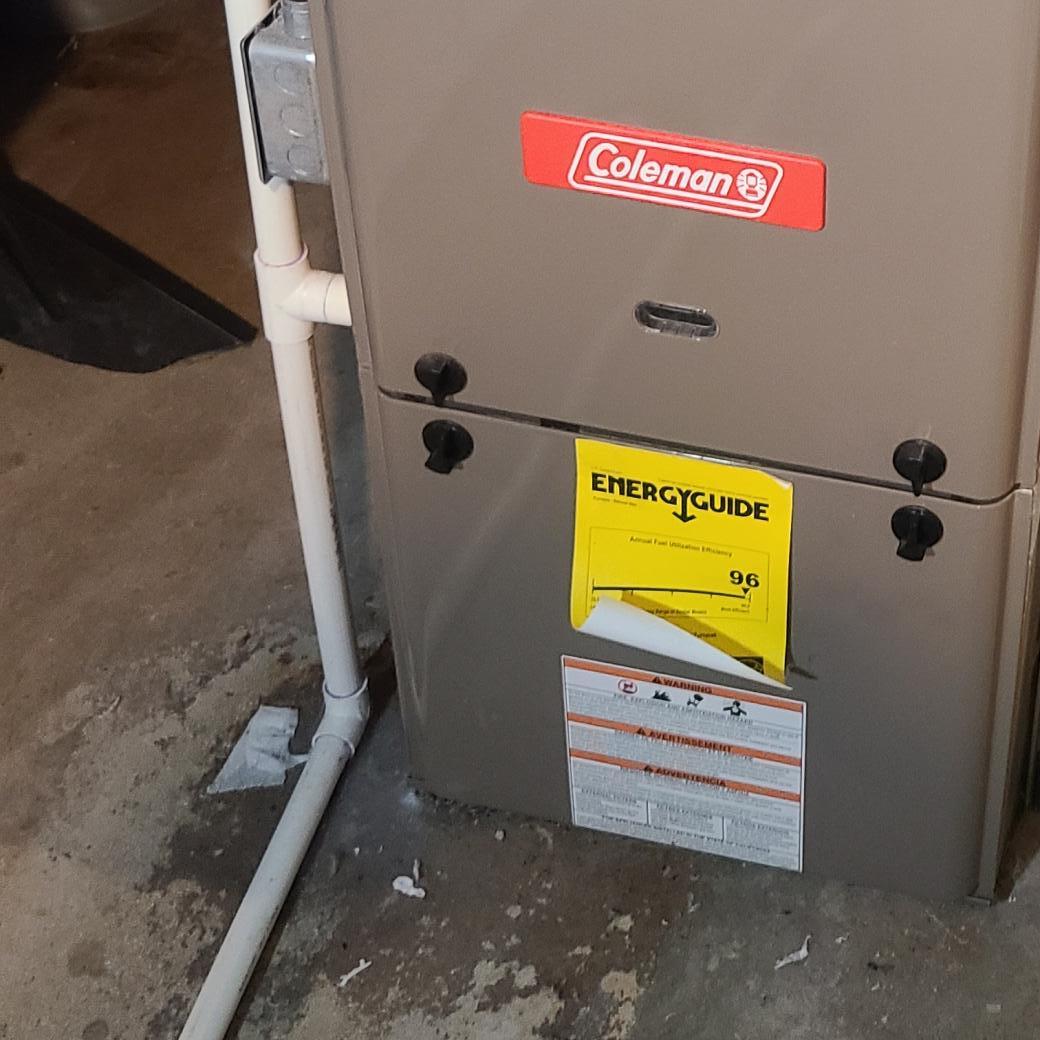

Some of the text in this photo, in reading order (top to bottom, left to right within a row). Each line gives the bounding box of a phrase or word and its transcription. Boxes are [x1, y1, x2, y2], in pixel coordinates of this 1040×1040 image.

[586, 142, 733, 197] Coleman
[591, 472, 770, 522] ENERGYGUIDE
[630, 536, 732, 558] Annual Fuel Utilization Efficiency
[729, 570, 760, 588] 96
[664, 678, 713, 694] WARNING
[656, 768, 726, 788] ADVERTENCIA
